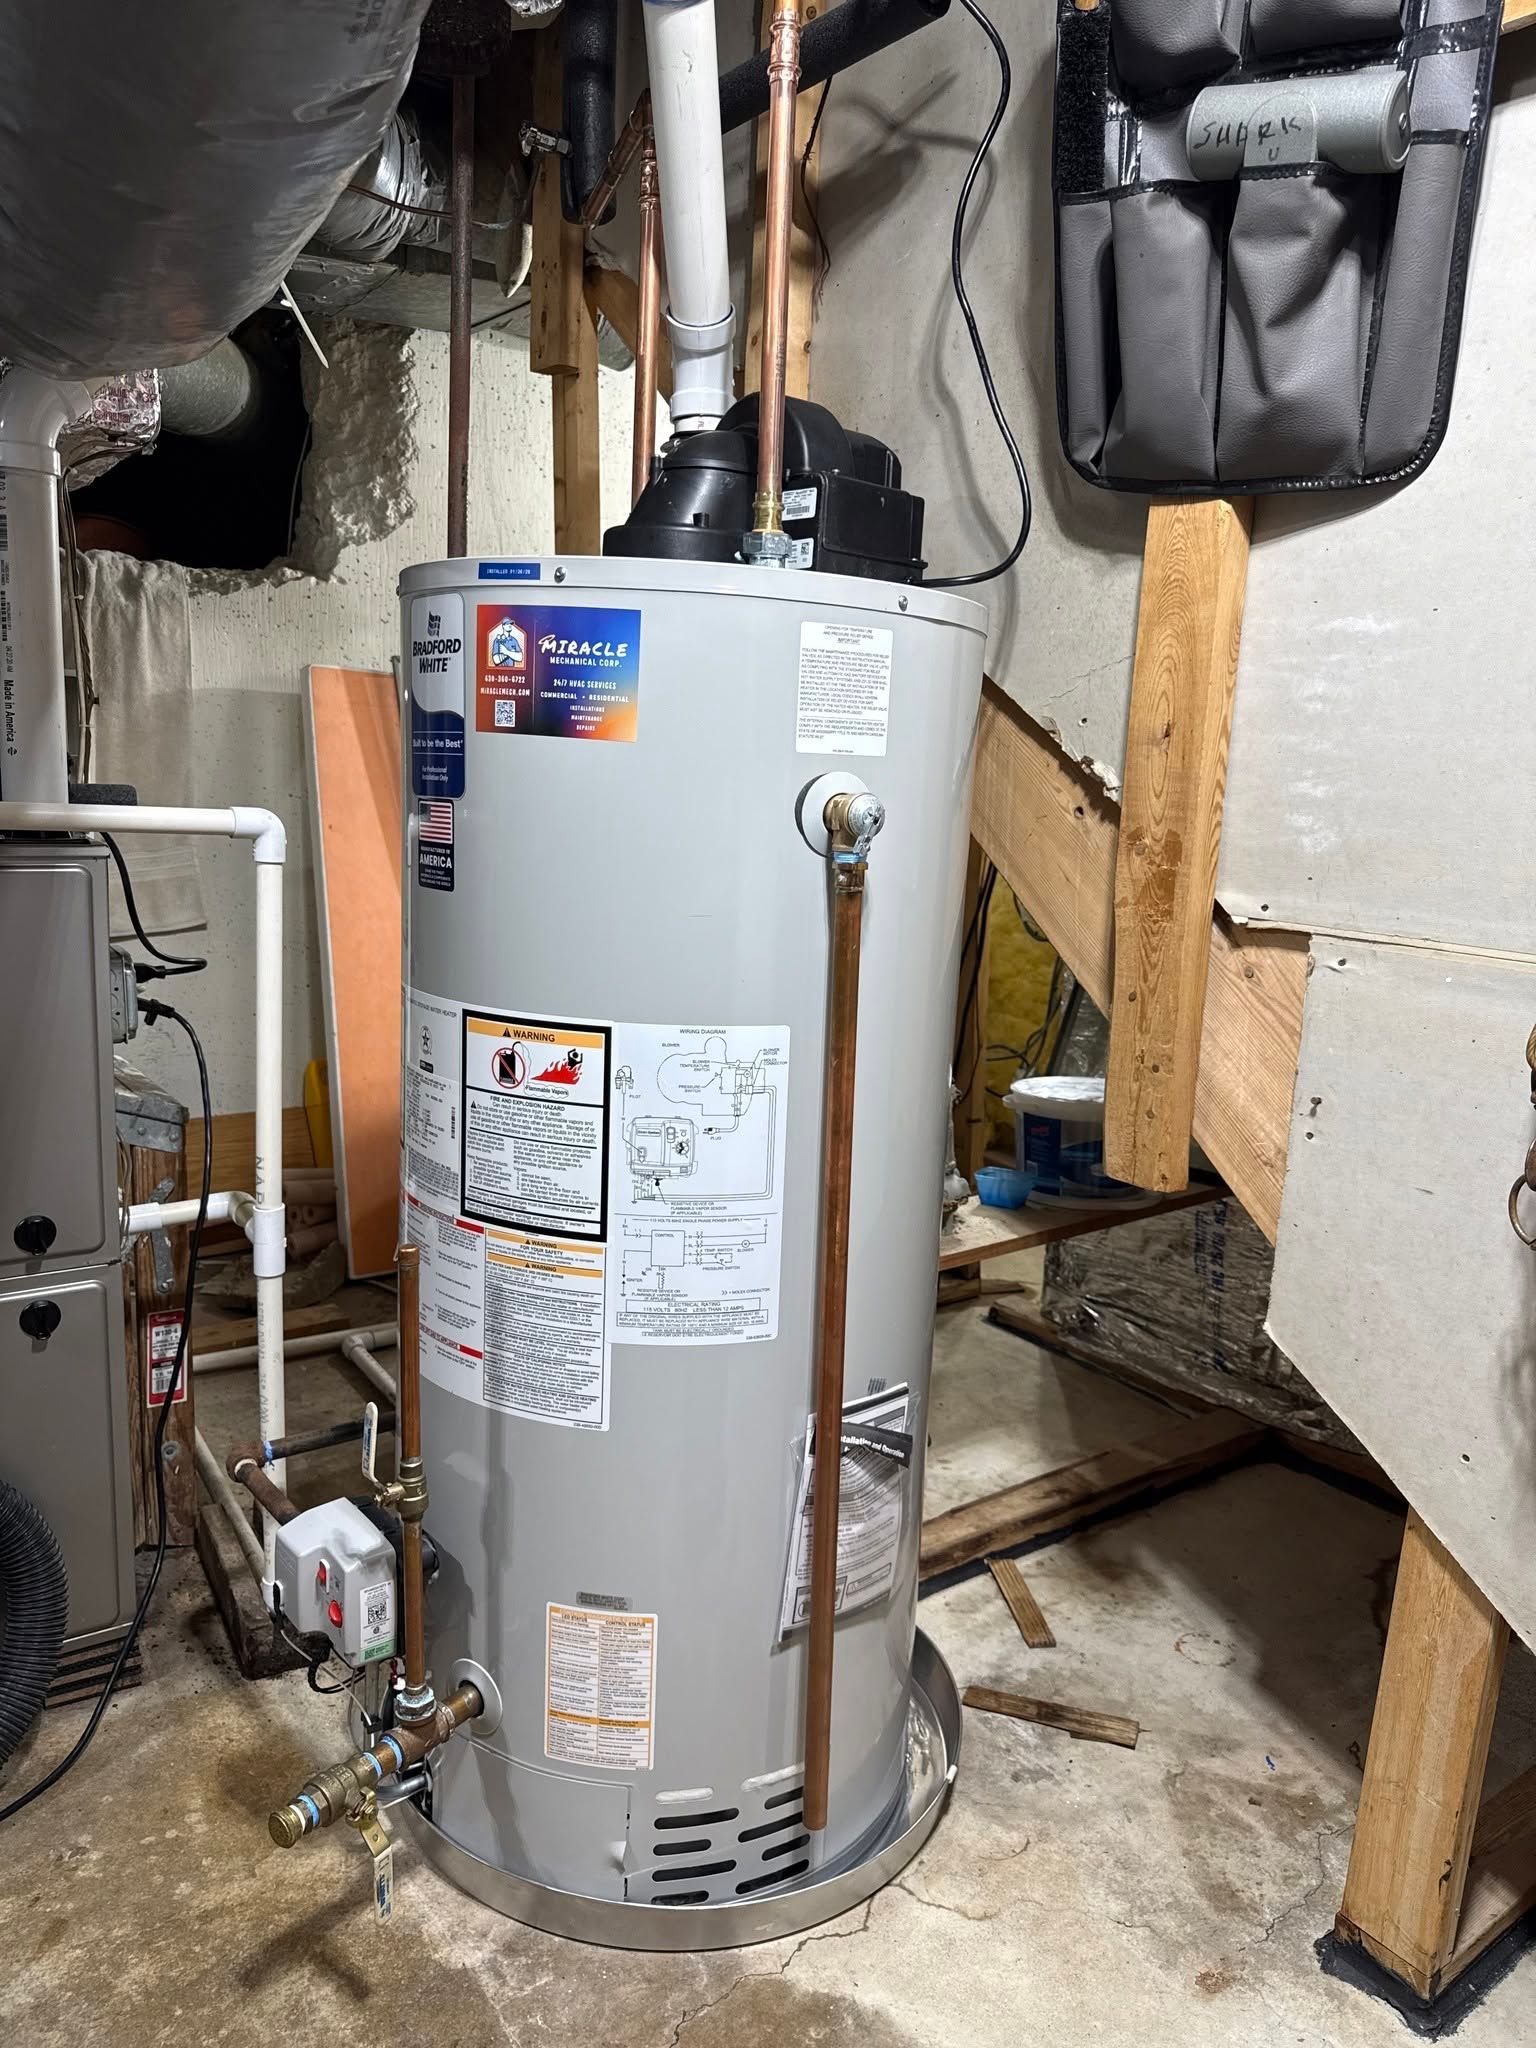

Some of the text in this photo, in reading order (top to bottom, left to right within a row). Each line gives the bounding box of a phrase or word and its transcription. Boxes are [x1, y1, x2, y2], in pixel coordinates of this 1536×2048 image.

[1193, 116, 1301, 149] SHARK
[413, 638, 461, 656] BRADFORD
[541, 639, 628, 658] MIRACLE
[419, 658, 448, 674] WHITE
[550, 656, 622, 668] MECHANICAL CORP.
[569, 680, 585, 688] HVAC
[587, 681, 617, 690] SERVICES
[540, 691, 630, 703] COMMERCIAL RESIDENTIAL
[4, 679, 16, 742] Made in America
[427, 739, 434, 748] be
[434, 739, 445, 748] the
[420, 854, 452, 868] AMERICA
[513, 1029, 556, 1042] WARNING
[525, 1084, 568, 1096] Flammable Vapors
[513, 1099, 541, 1109] EXPLOSION
[531, 1240, 557, 1249] WARNING
[531, 1263, 557, 1272] WARNING
[872, 1442, 882, 1450] and
